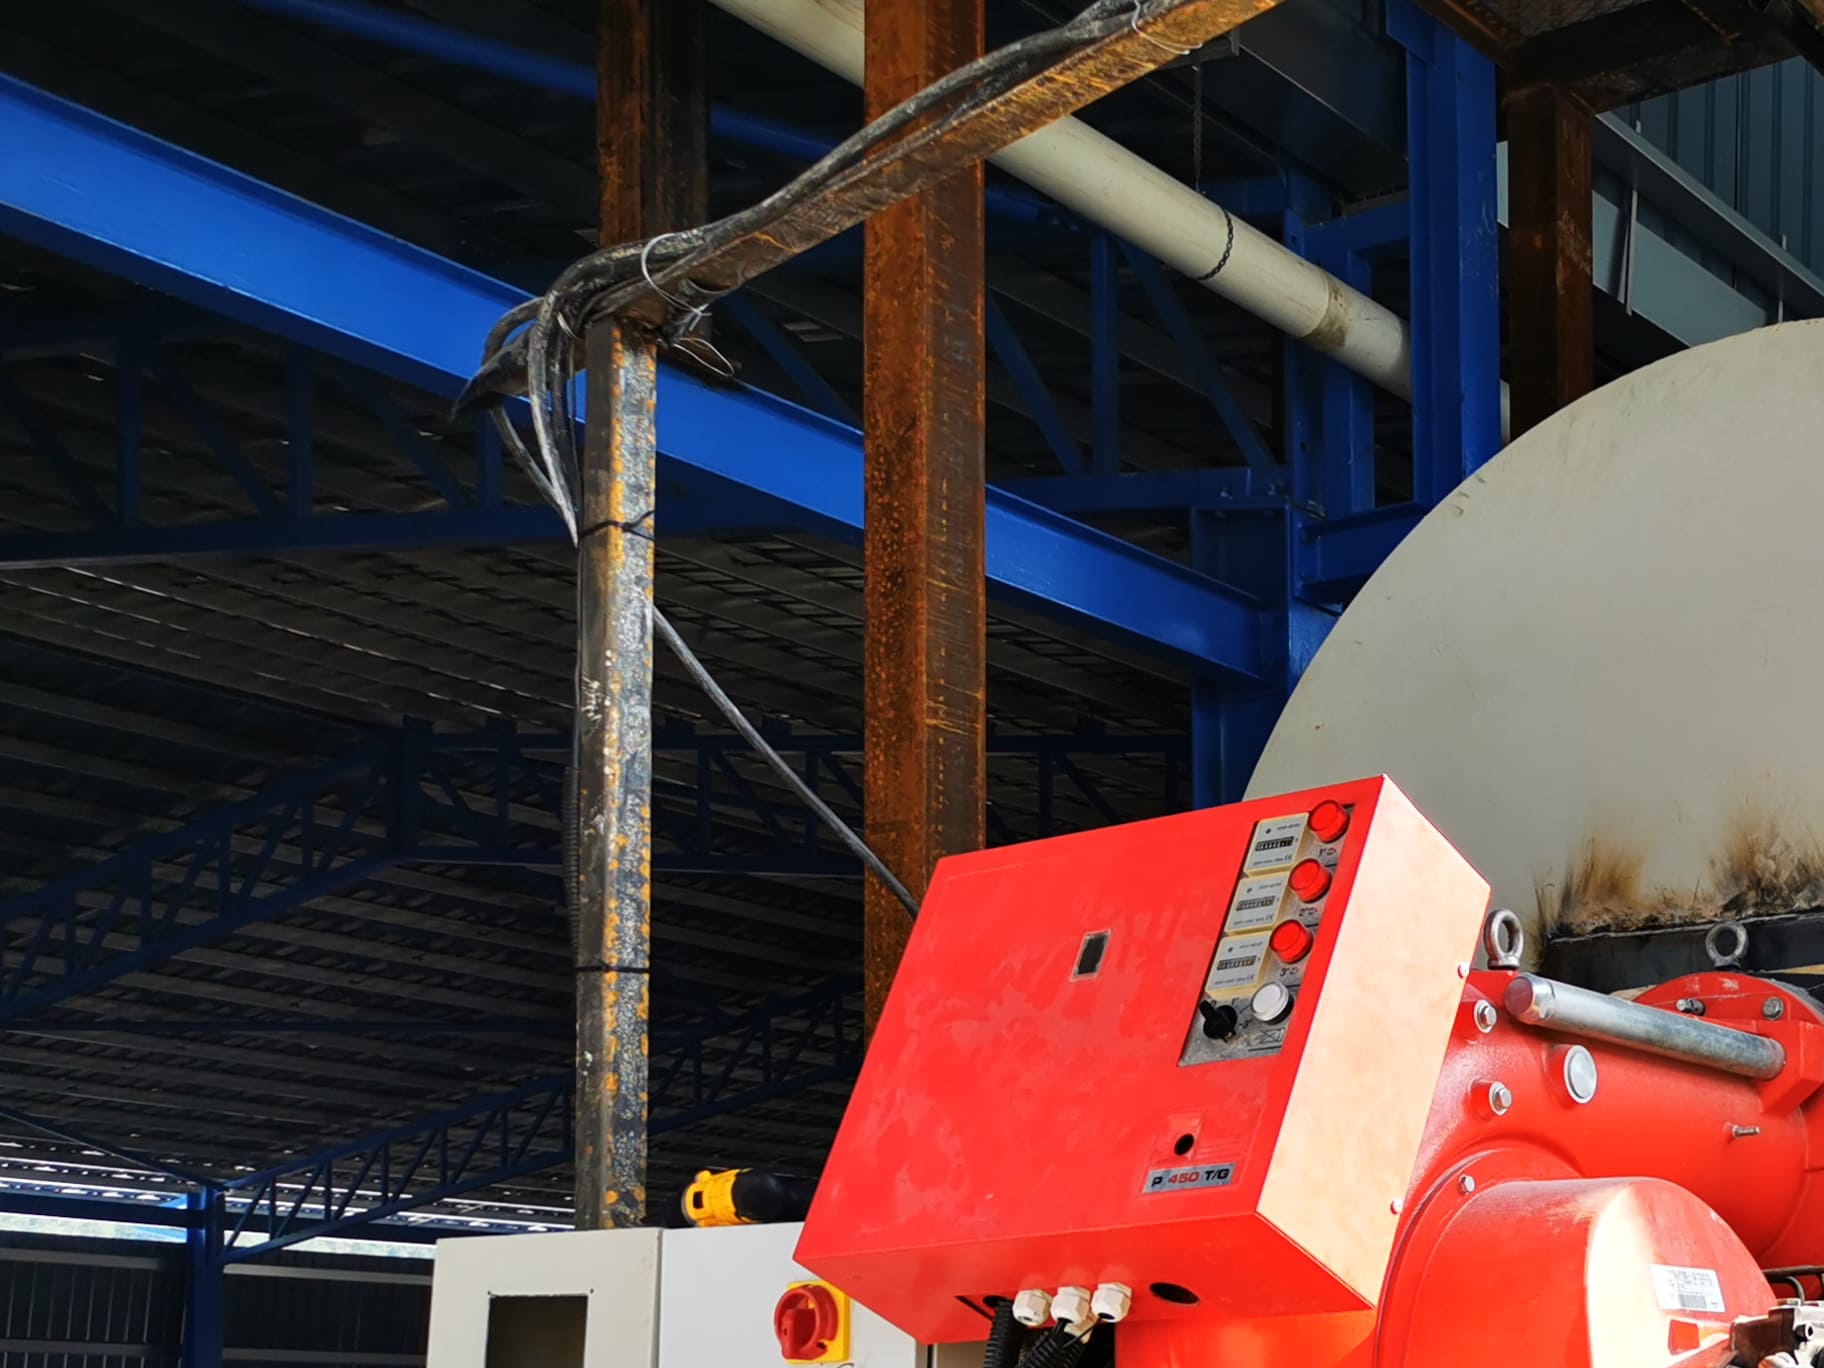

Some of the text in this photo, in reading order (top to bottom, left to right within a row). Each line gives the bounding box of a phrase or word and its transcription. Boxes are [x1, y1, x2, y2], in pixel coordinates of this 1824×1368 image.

[1151, 1168, 1230, 1188] P 450 T/G
